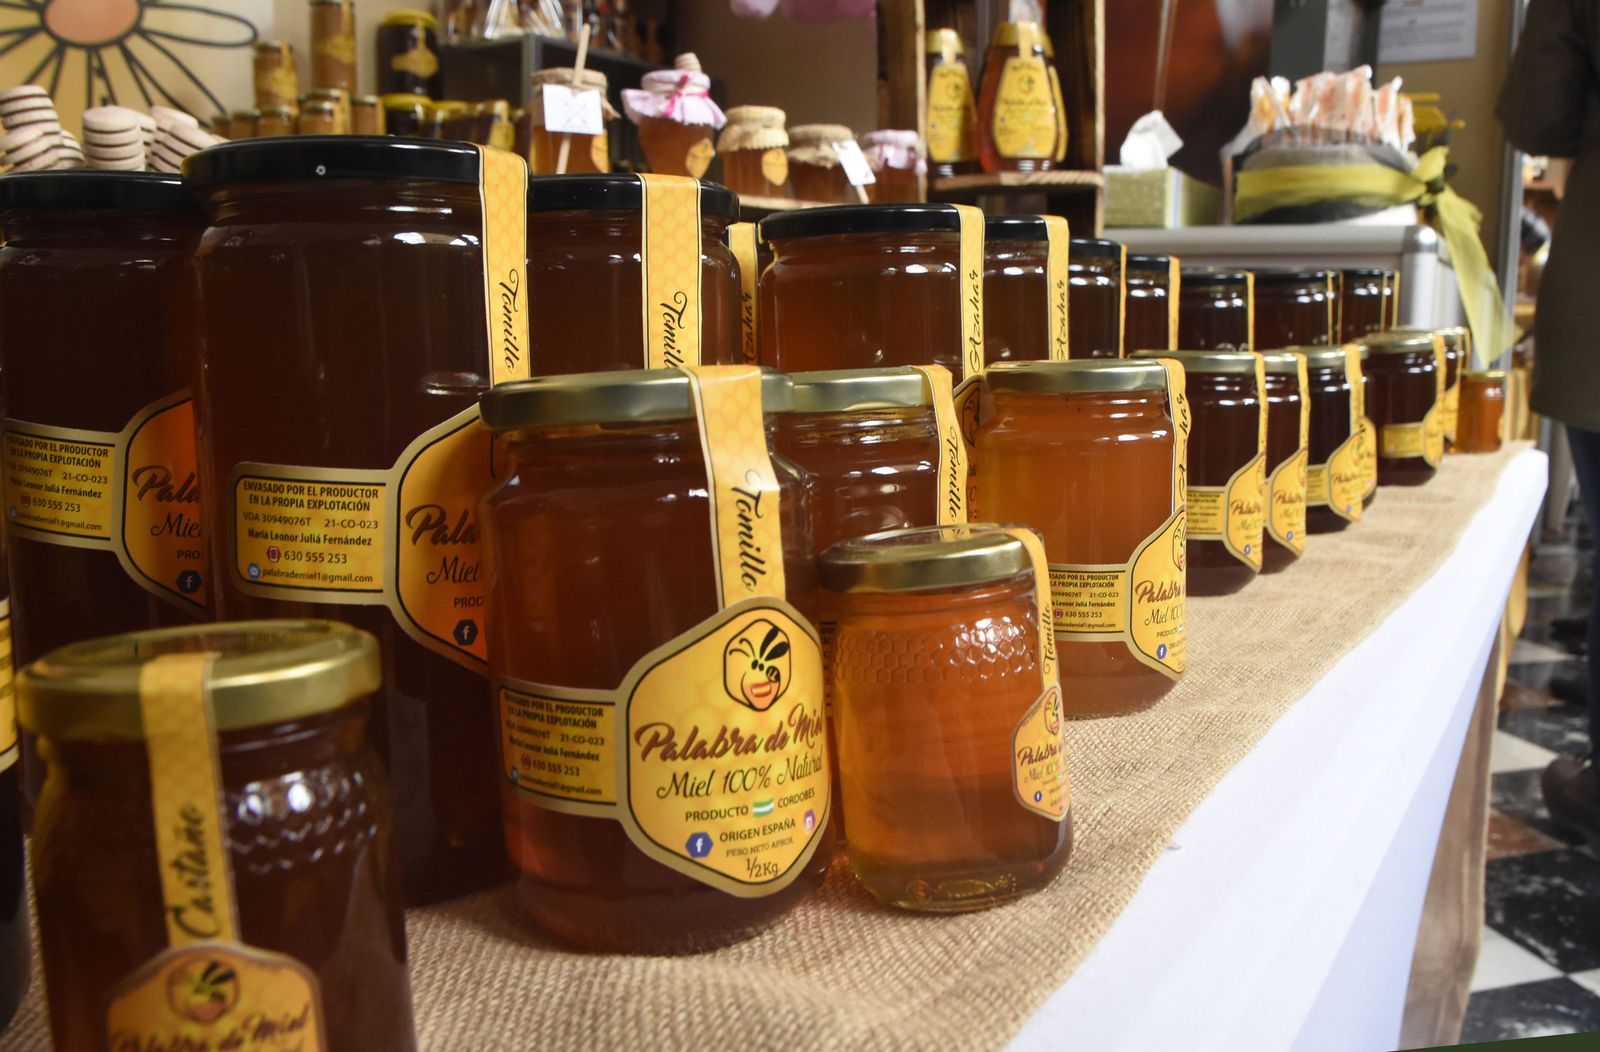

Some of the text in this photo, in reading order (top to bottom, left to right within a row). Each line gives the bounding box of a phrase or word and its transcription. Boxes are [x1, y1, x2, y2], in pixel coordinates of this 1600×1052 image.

[498, 268, 521, 374] Tomillo
[659, 291, 688, 368] Tomill
[34, 440, 48, 450] POR
[50, 443, 57, 452] EL
[59, 444, 109, 457] PRODUCTOR
[50, 454, 101, 468] EXPLOTACIÓN
[62, 472, 108, 484] 21-CO-023
[946, 426, 961, 523] Tomillo
[61, 486, 102, 498] Fernández
[244, 481, 379, 499] ENVASADO POR EL PRODUCTOR
[32, 497, 81, 513] 630 555 253
[249, 494, 371, 511] EN LA PROPIA EXPLOTACIÓN
[324, 518, 379, 529] 21-CO-023
[730, 468, 767, 593] Tomillo
[270, 531, 298, 543] Leonor
[300, 533, 321, 545] Juliá
[323, 534, 372, 546] Fernández
[284, 550, 347, 564] 630 555 253
[1067, 573, 1079, 581] POR
[1079, 580, 1115, 588] EXPLOTACIÓN
[1144, 606, 1169, 626] Miel
[555, 704, 604, 717] PRODUCTOR
[560, 734, 605, 746] 21-CO-023
[634, 721, 764, 763] Palabra
[764, 719, 790, 751] de
[560, 748, 599, 761] Fernández
[564, 766, 580, 777] 253
[656, 743, 823, 800] Miel 100% Natural
[685, 805, 749, 822] PRODUCTO
[719, 818, 796, 843] ORIGEN ESPAÑA
